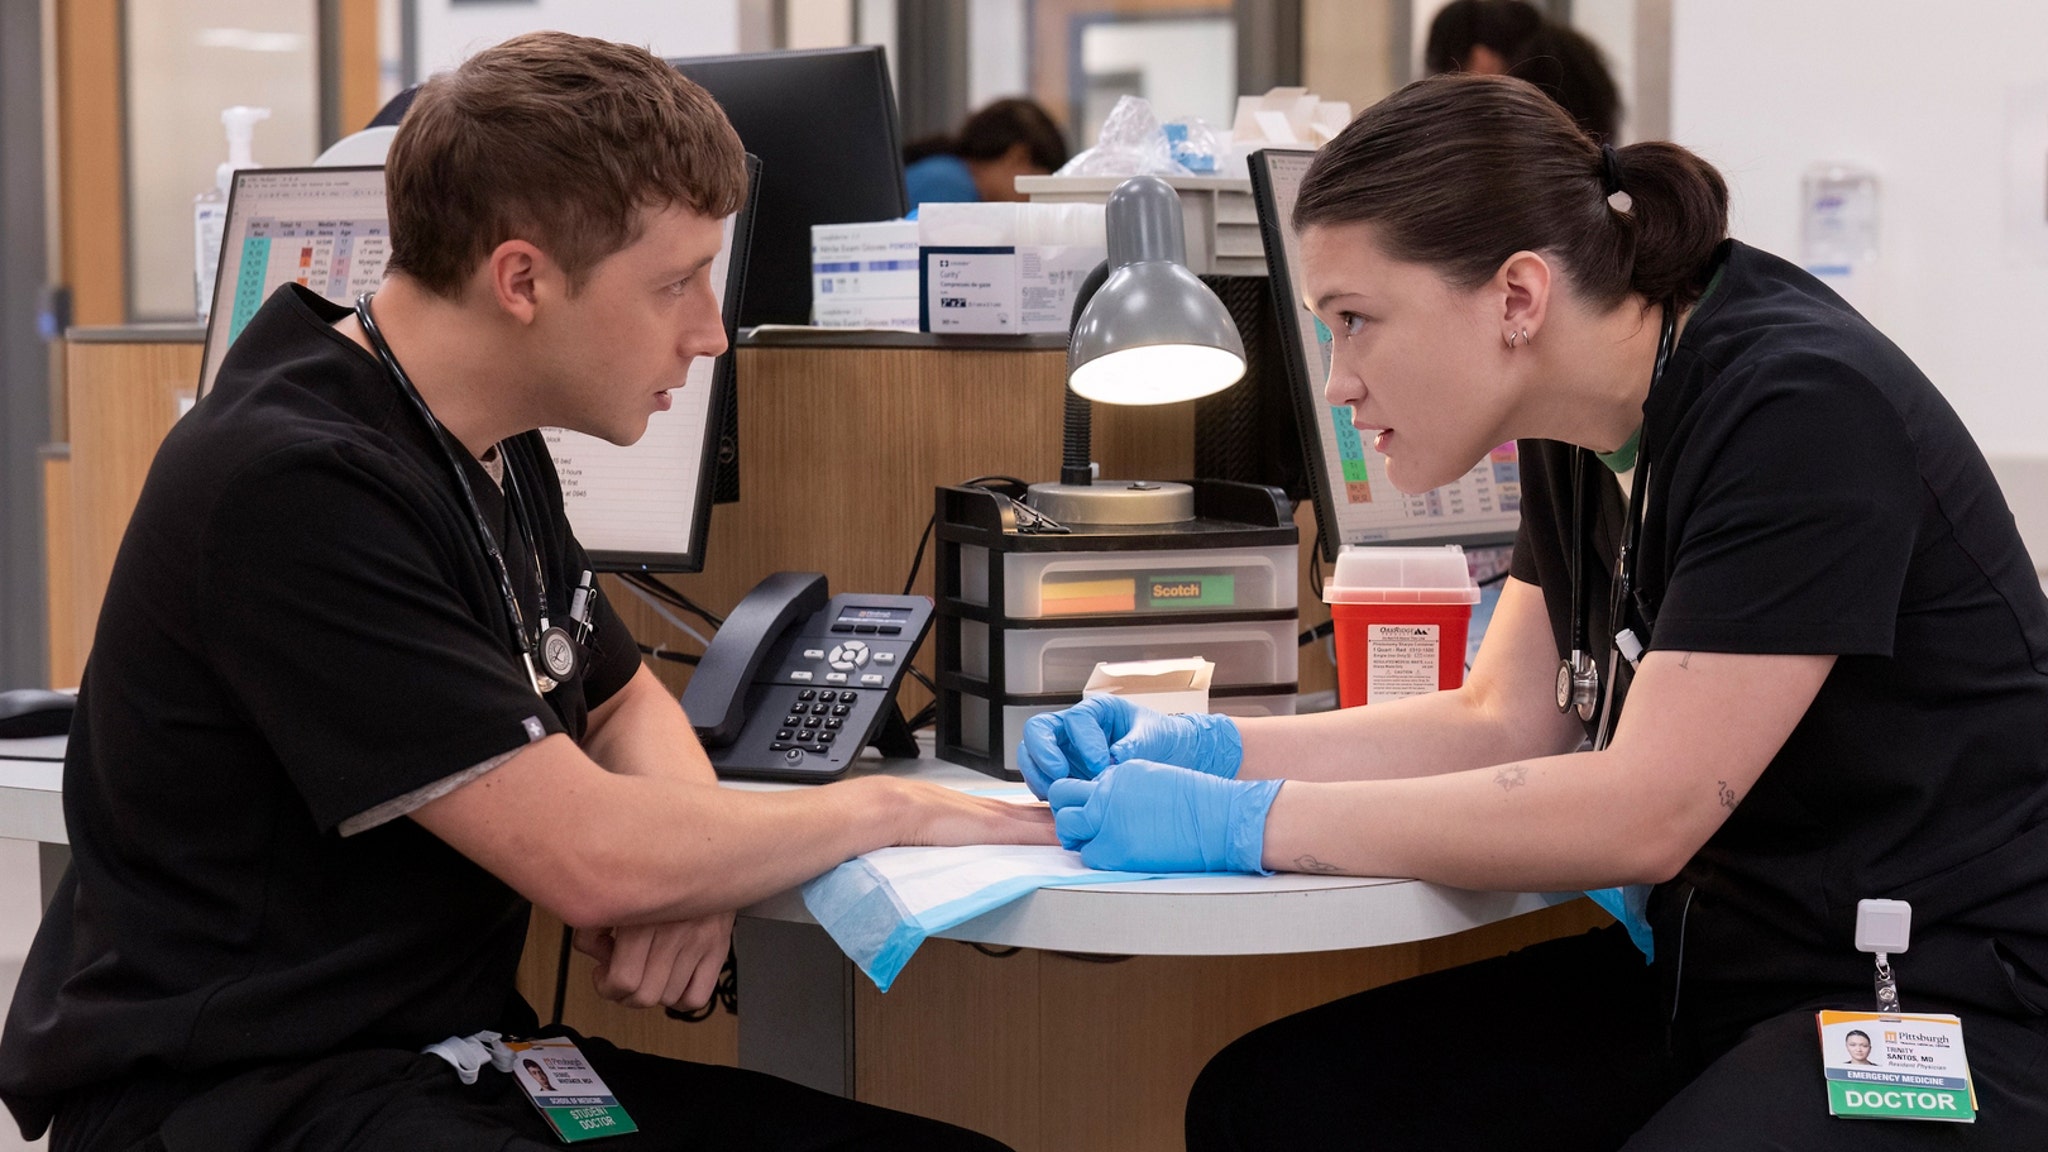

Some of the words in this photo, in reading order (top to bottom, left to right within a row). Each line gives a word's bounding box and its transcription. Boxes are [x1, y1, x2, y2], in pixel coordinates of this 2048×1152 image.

[1153, 583, 1199, 598] Scotch
[1899, 1032, 1949, 1044] Pittsburgh
[1847, 1071, 1900, 1082] EMERGENCY
[1901, 1075, 1944, 1086] MEDICINE
[1845, 1090, 1957, 1110] DOCTOR
[569, 1106, 609, 1120] STUDENT
[579, 1116, 616, 1130] DOCTOR
